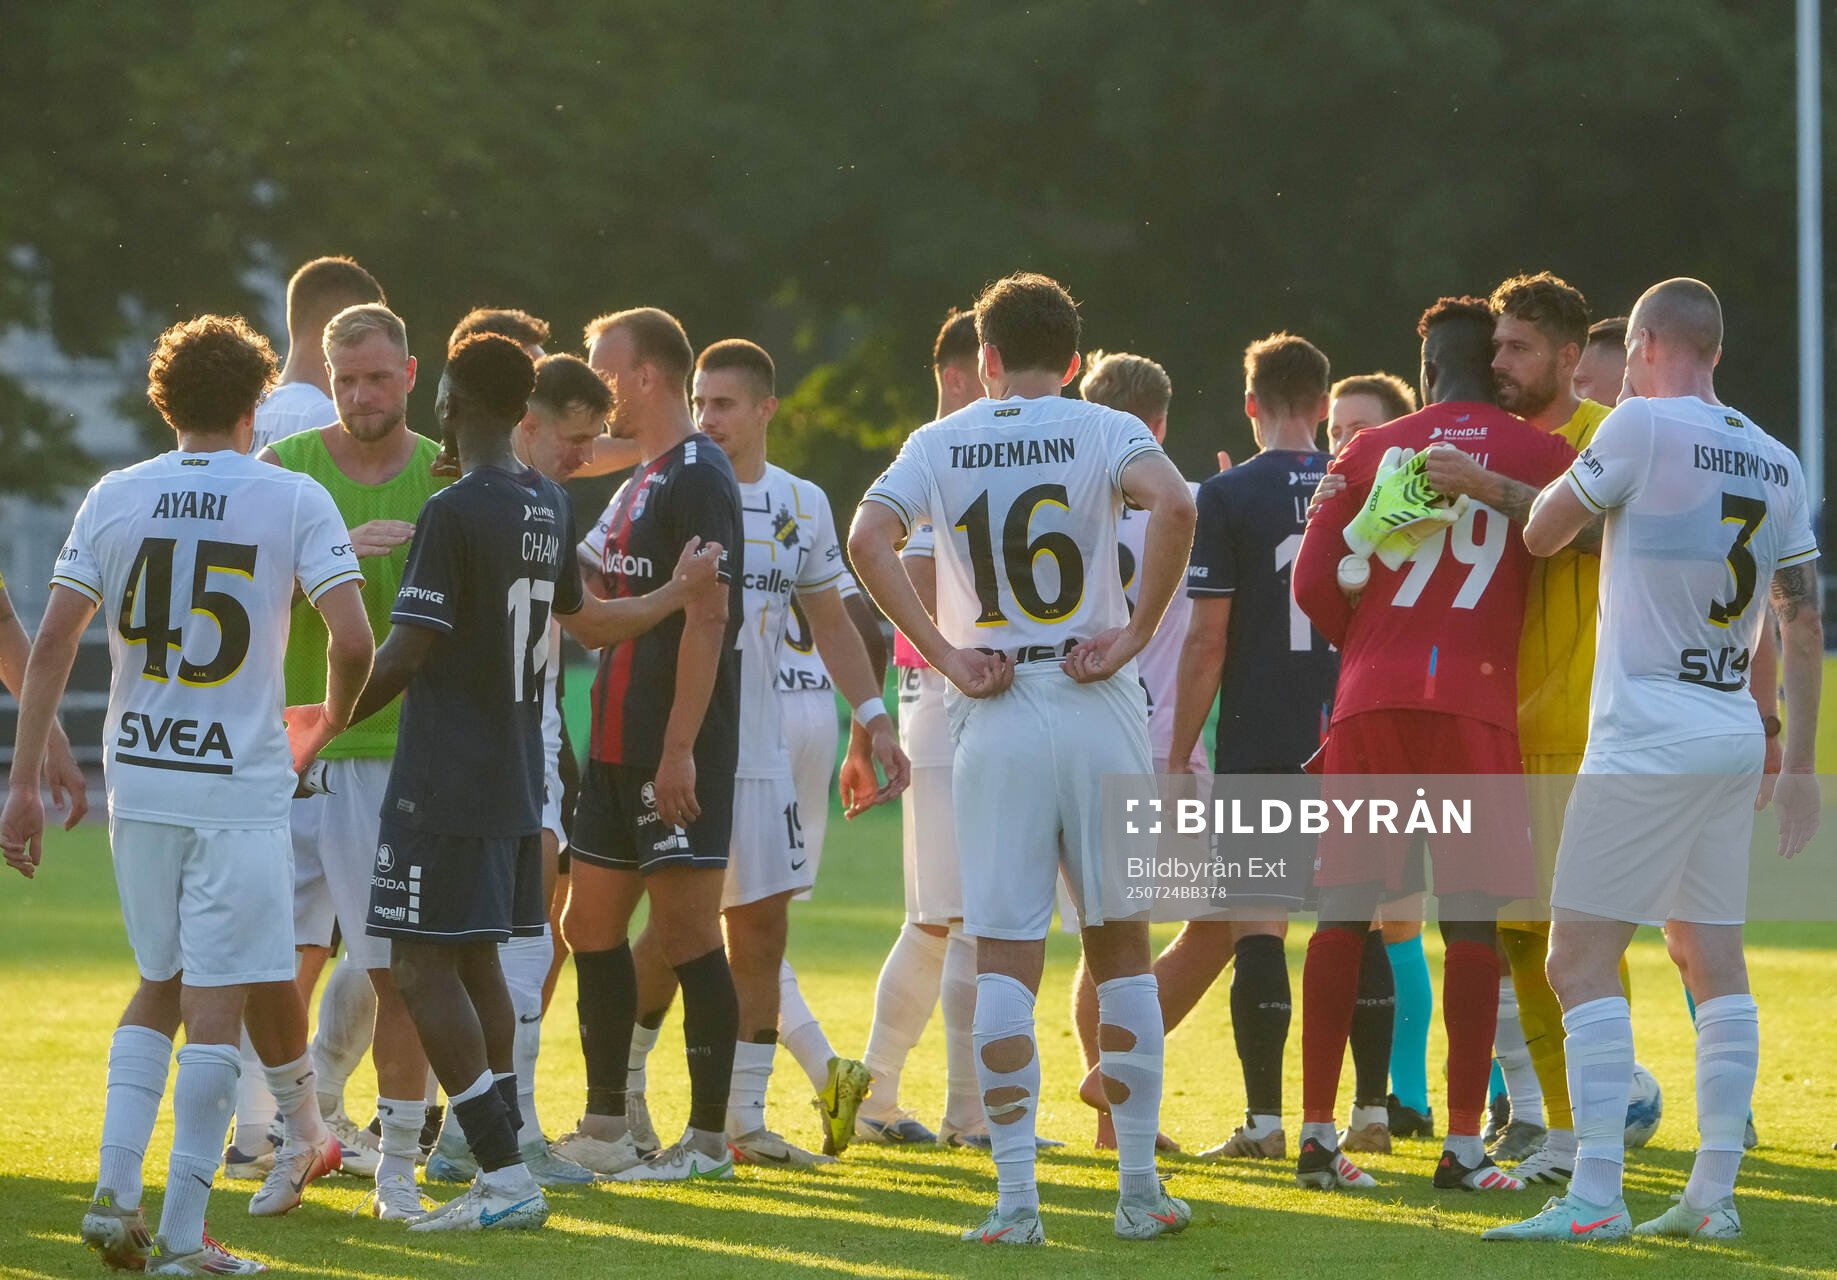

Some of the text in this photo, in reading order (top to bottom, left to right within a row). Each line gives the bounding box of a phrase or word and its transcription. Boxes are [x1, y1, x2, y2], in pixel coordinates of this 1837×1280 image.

[1444, 427, 1488, 437] KINDLE
[949, 437, 1075, 469] TIEDEMANN
[152, 491, 228, 521] AYARI
[521, 532, 559, 565] CHAM
[955, 483, 1085, 627] 16
[1709, 491, 1767, 628] 3
[118, 537, 259, 688] 45
[117, 711, 234, 760] SVEA
[374, 905, 406, 918] capelli
